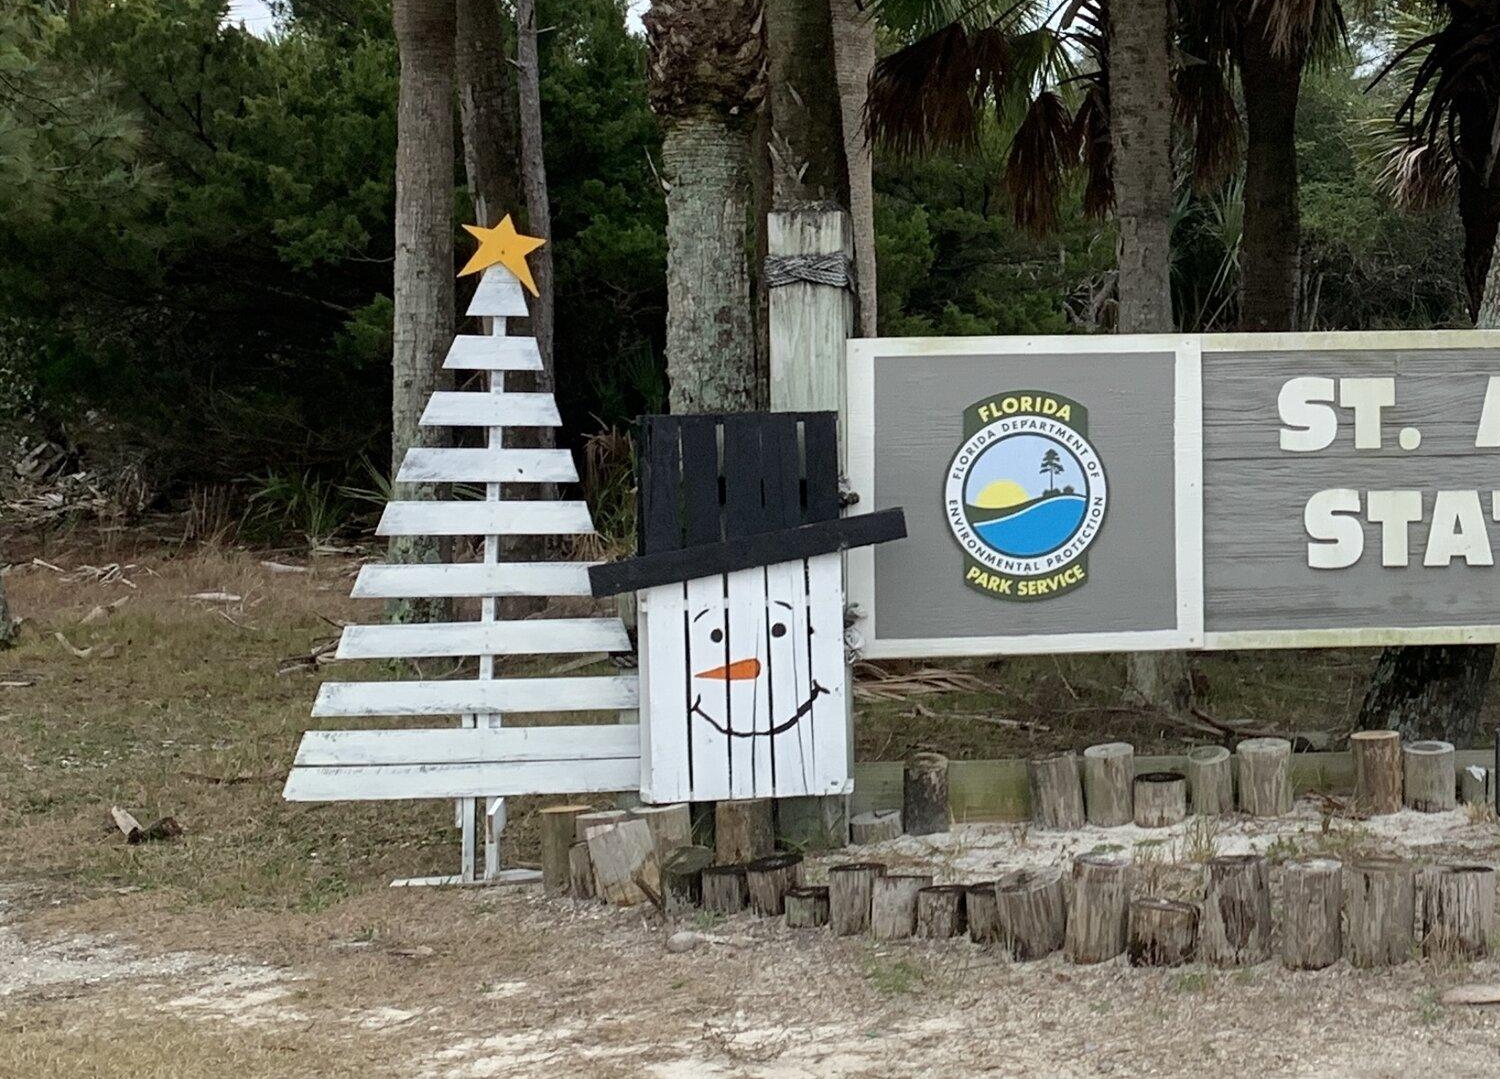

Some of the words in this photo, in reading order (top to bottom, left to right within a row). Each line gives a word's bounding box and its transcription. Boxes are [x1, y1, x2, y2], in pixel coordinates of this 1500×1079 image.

[978, 396, 1072, 422] FLORIDA
[1277, 376, 1421, 451] ST.
[952, 429, 996, 480] FLORIDA
[1001, 419, 1089, 456] DEPARTMENT
[1087, 461, 1100, 478] OF
[949, 499, 1040, 571] ENVIRONMENTAL
[1047, 496, 1103, 567] PROTECTION
[966, 566, 1012, 594] PARK
[1017, 564, 1085, 595] SERVICE
